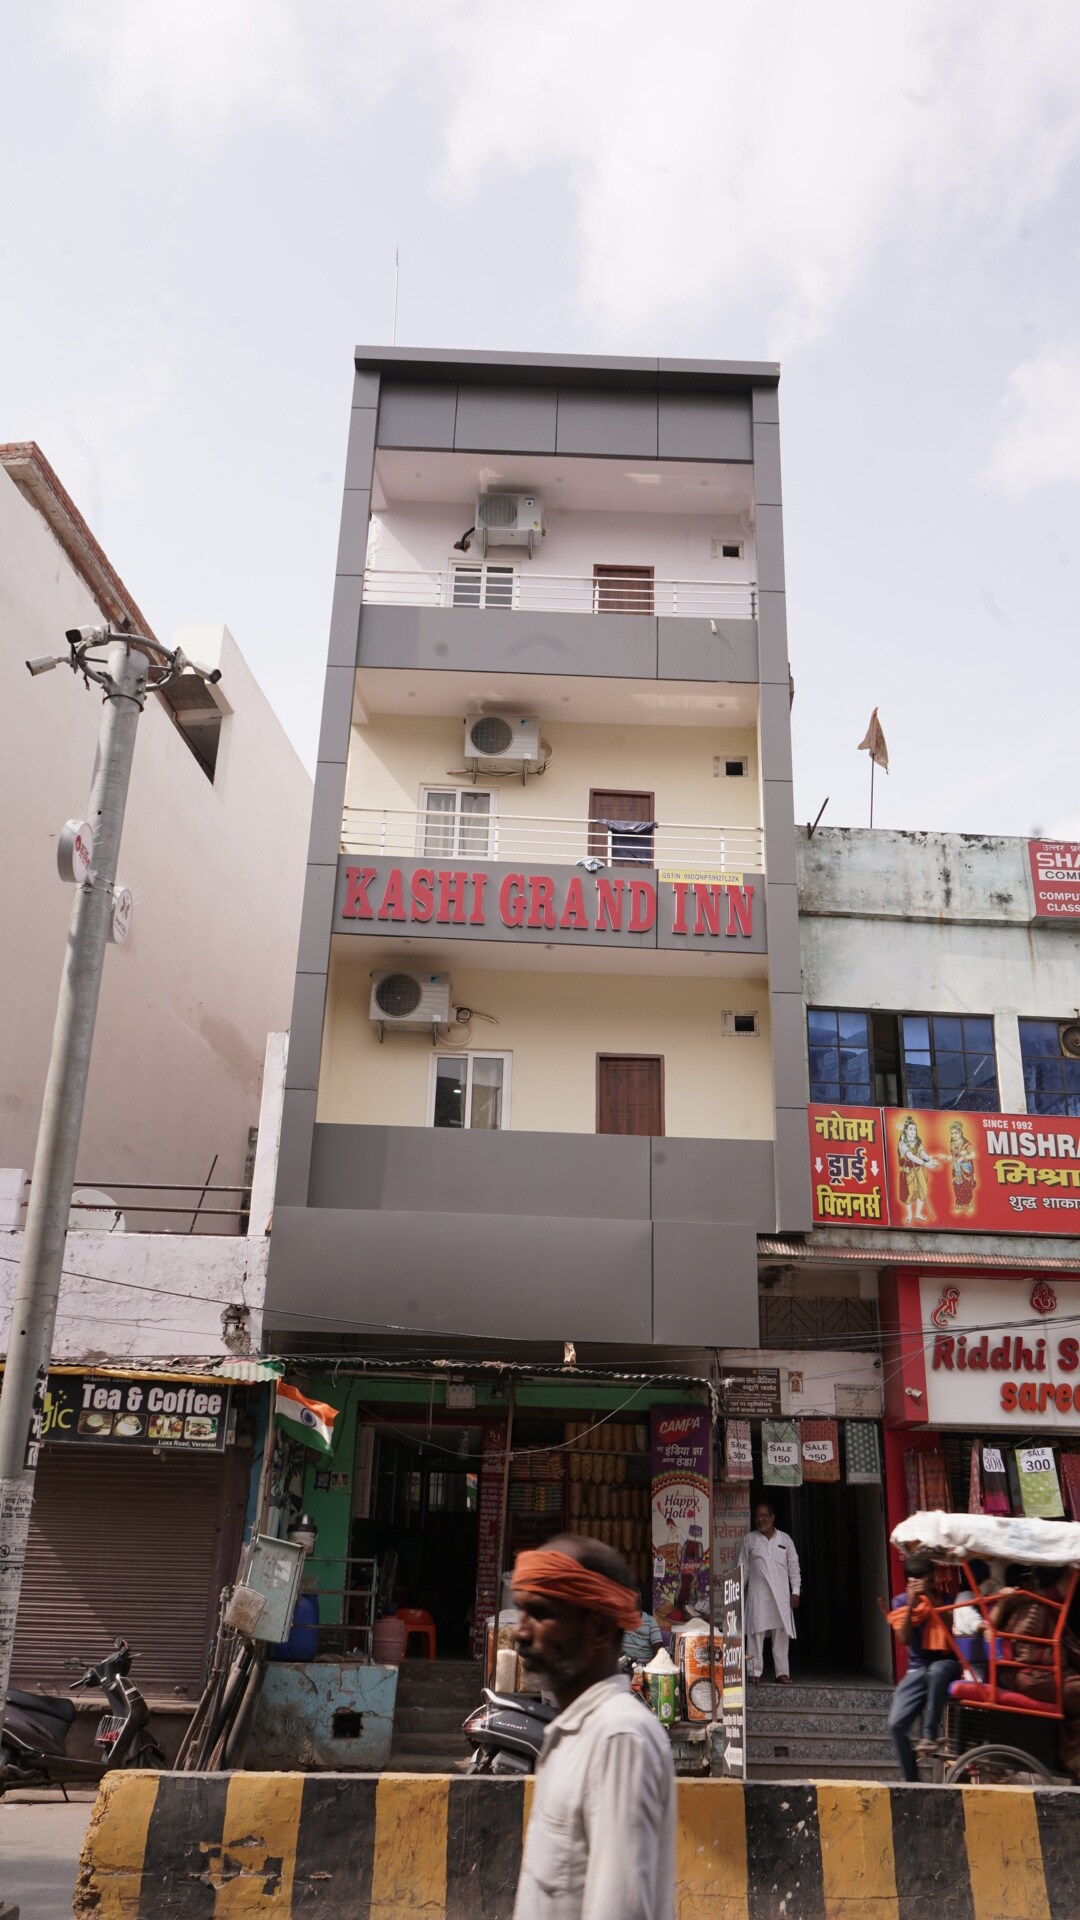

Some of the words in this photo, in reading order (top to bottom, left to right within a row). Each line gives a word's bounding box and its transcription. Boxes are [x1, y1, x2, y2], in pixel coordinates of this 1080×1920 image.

[1045, 870, 1080, 880] COM
[342, 866, 487, 926] KASHI
[500, 872, 657, 934] GRAND
[672, 882, 754, 937] INN
[1039, 891, 1080, 901] COMPU
[814, 1111, 875, 1142] नरोत्तम
[983, 1119, 1008, 1129] SINCE
[1011, 1121, 1033, 1130] 1992
[986, 1131, 1080, 1158] MISHR
[826, 1147, 867, 1186] ड्राई
[1009, 1195, 1037, 1211] शुद्ध
[1043, 1197, 1080, 1210] शाका
[932, 1335, 1046, 1371] Riddhi
[82, 1383, 121, 1411] Tea
[127, 1386, 143, 1412] &
[148, 1387, 222, 1415] Coffee
[660, 1416, 701, 1434] CAMPA
[665, 1444, 690, 1456] इंडिया
[692, 1447, 704, 1456] का
[730, 1441, 747, 1450] SALE
[769, 1444, 792, 1453] SALE
[805, 1443, 828, 1451] SALE
[732, 1451, 746, 1460] 300
[773, 1455, 791, 1463] 150
[1027, 1449, 1046, 1457] SALE
[984, 1457, 1003, 1470] 300
[1026, 1459, 1051, 1471] 300
[664, 1494, 700, 1509] Happy
[664, 1507, 686, 1519] Holi
[724, 1579, 740, 1605] Elite
[727, 1610, 738, 1637] Silk
[723, 1643, 742, 1669] Factory
